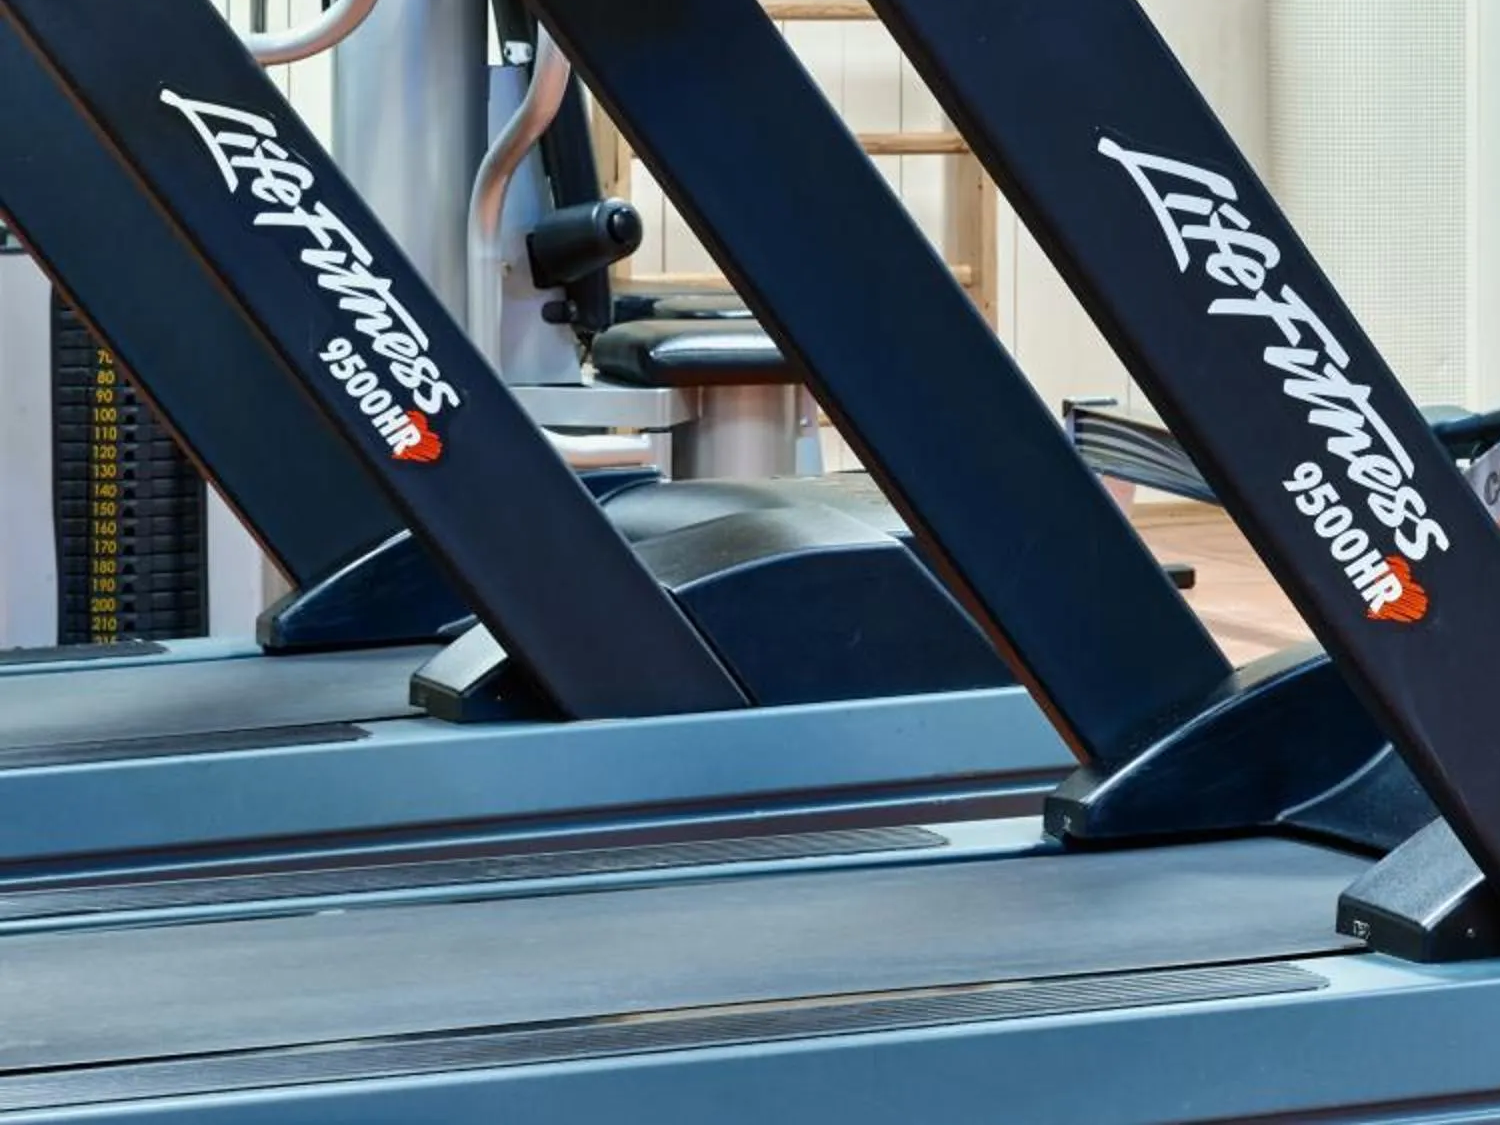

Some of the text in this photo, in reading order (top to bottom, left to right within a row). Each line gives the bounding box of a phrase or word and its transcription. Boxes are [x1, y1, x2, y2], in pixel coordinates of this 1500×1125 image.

[159, 88, 460, 416] Life Fitness
[1097, 136, 1451, 562] Life Fitness
[96, 388, 113, 404] 90
[318, 337, 422, 457] 9500HR
[95, 407, 117, 423] 100
[95, 426, 117, 441] 110
[94, 445, 117, 460] 120
[94, 463, 117, 478] 130
[95, 483, 117, 498] 140
[94, 501, 116, 517] 150
[95, 520, 117, 536] 160
[1282, 461, 1404, 614] 9500HR
[95, 539, 117, 554] 170
[94, 558, 116, 574] 180
[93, 577, 116, 592] 190
[91, 597, 116, 613] 200
[92, 616, 117, 632] 210
